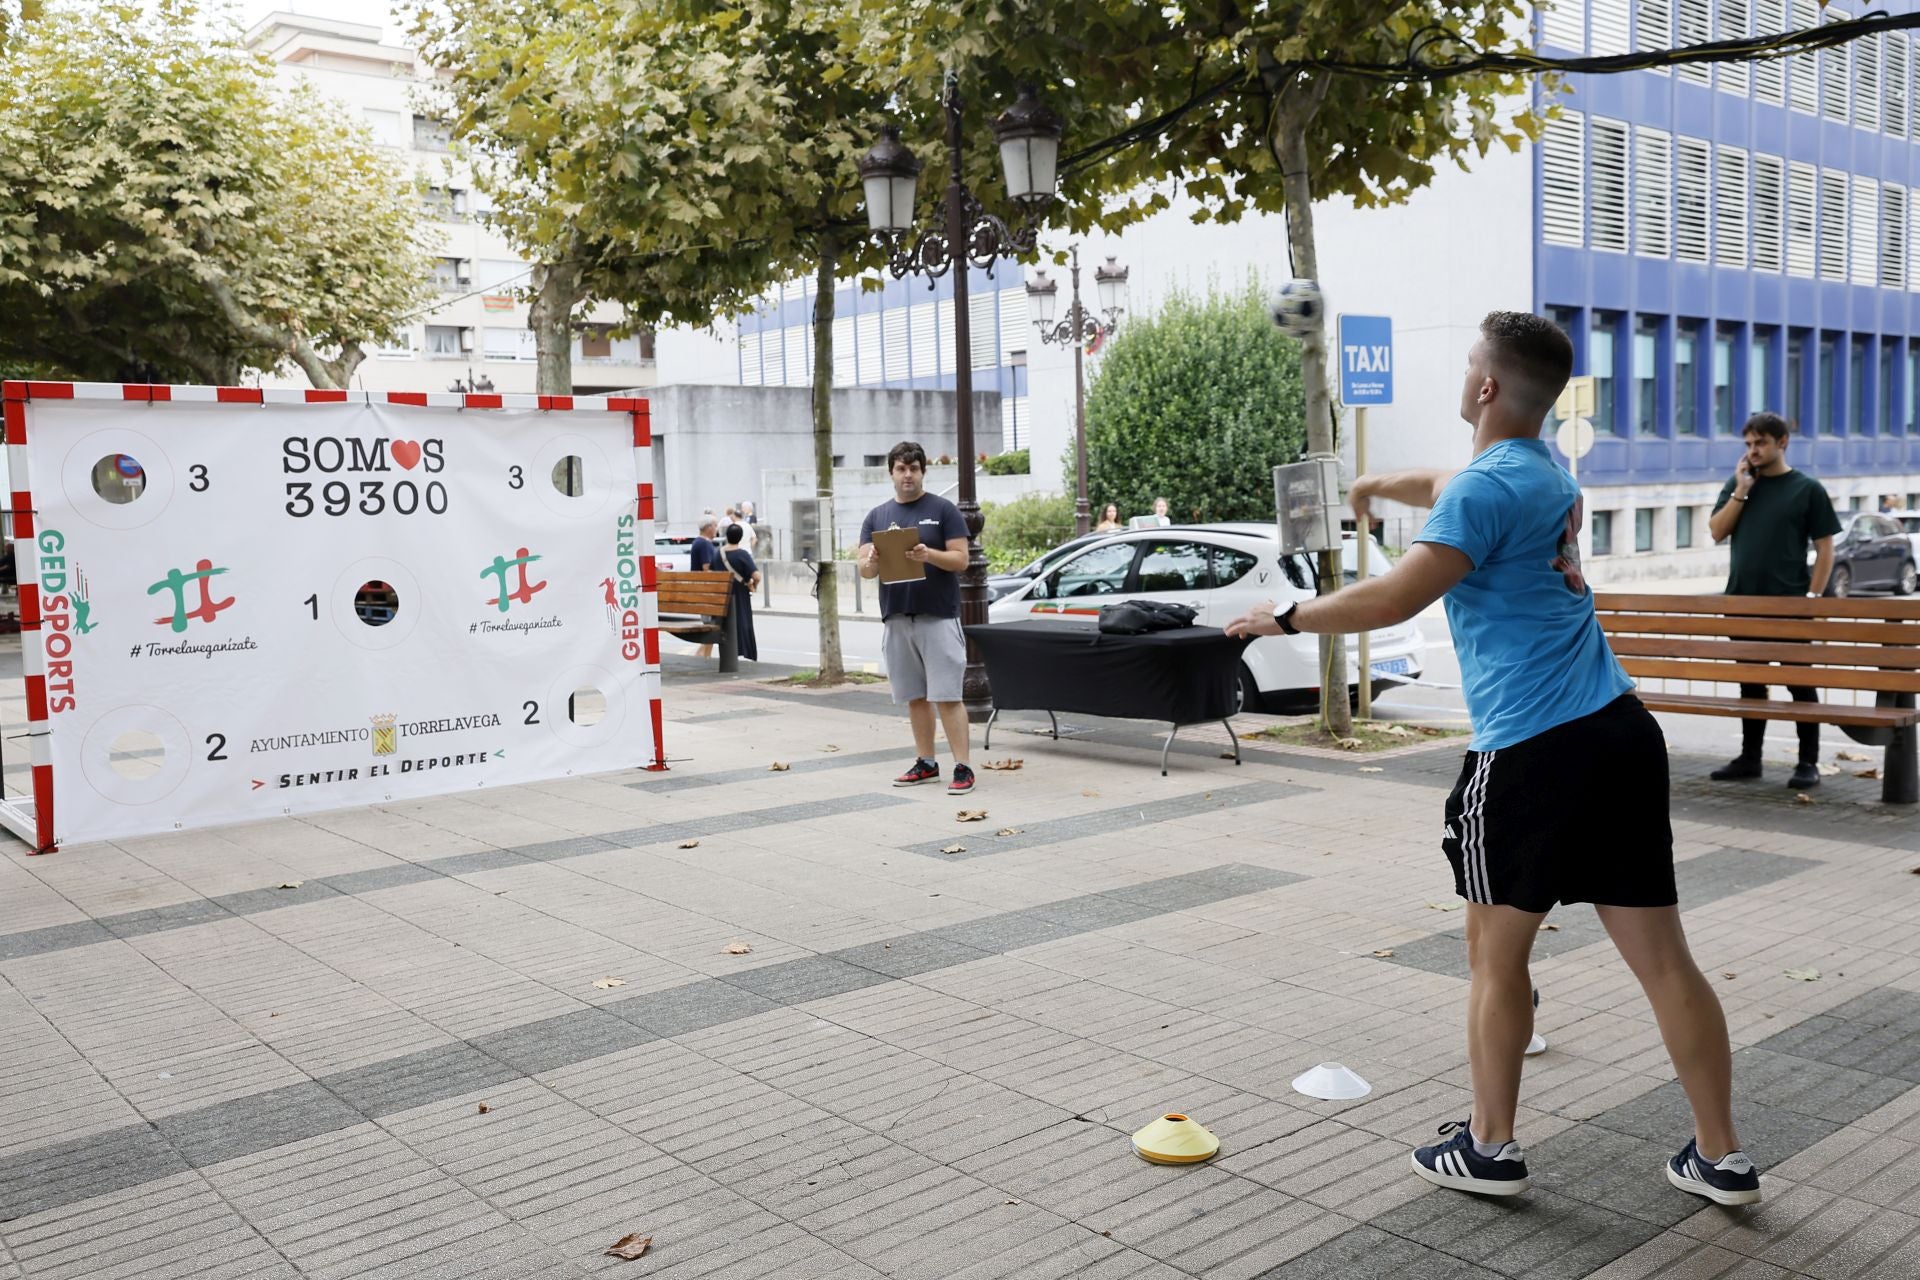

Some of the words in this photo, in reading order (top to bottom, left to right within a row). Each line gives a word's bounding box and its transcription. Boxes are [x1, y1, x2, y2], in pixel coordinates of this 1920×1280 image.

[1345, 346, 1389, 371] TAXI
[283, 437, 444, 473] SOMS
[189, 464, 209, 492] 3
[508, 465, 524, 489] 3
[286, 481, 448, 517] 39300
[616, 514, 640, 661] GEDSPORTS
[38, 529, 76, 713] GEDSPORTS
[304, 594, 318, 620] 1
[523, 701, 540, 725] 2
[206, 733, 228, 761] 2
[251, 728, 368, 752] AYUNTAMIENTO
[399, 714, 501, 737] TORRELAVEGA
[370, 764, 389, 777] EL
